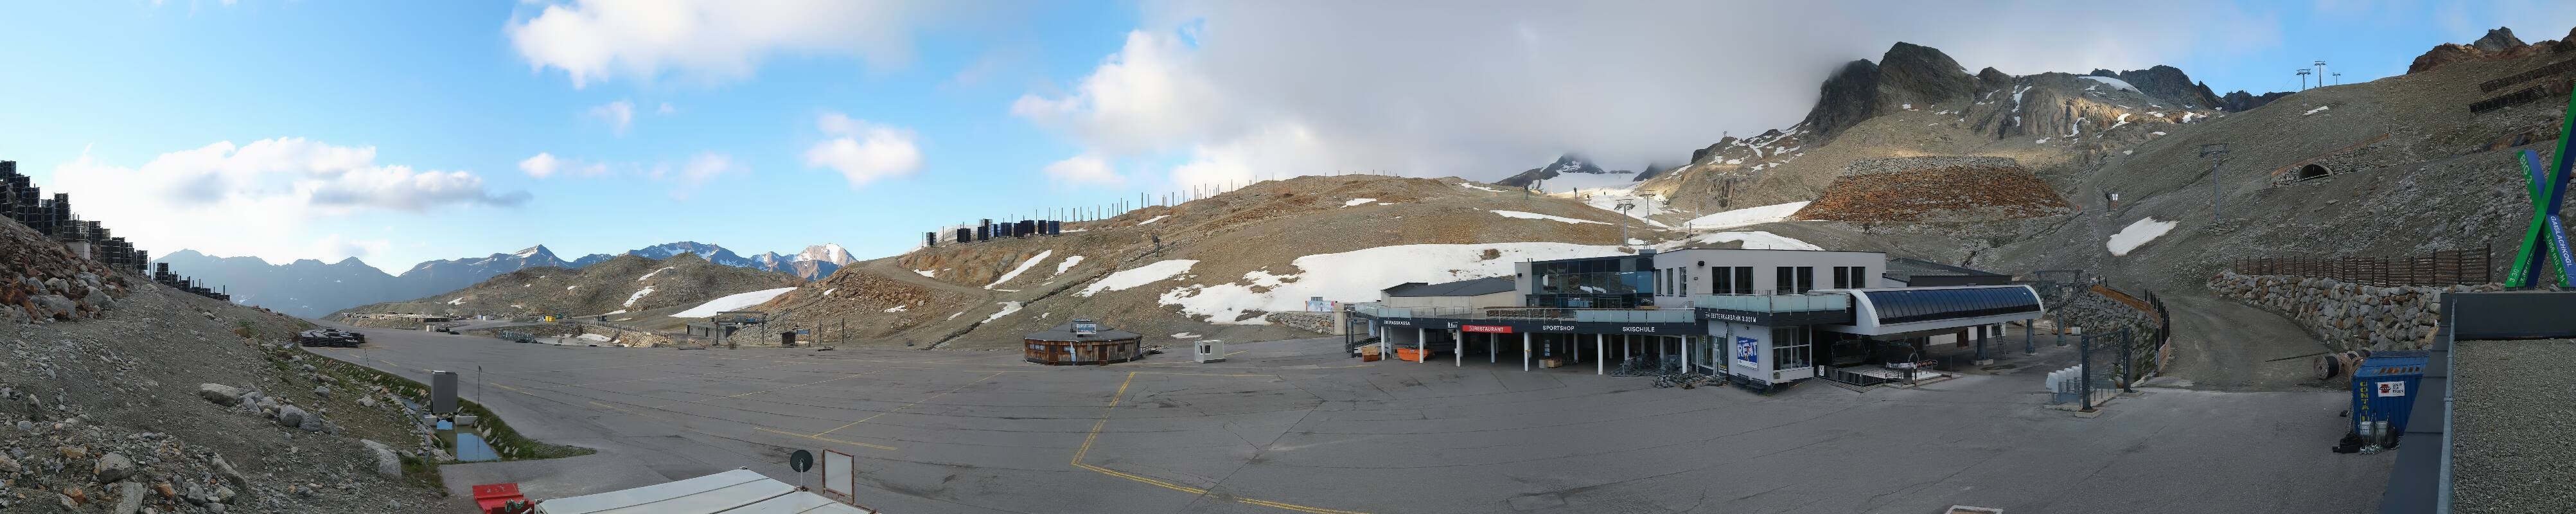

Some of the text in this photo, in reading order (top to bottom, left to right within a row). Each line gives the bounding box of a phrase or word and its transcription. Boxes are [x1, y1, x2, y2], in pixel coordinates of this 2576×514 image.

[2519, 154, 2532, 184] BIG 3
[2550, 216, 2573, 268] GAISLACHKOGL
